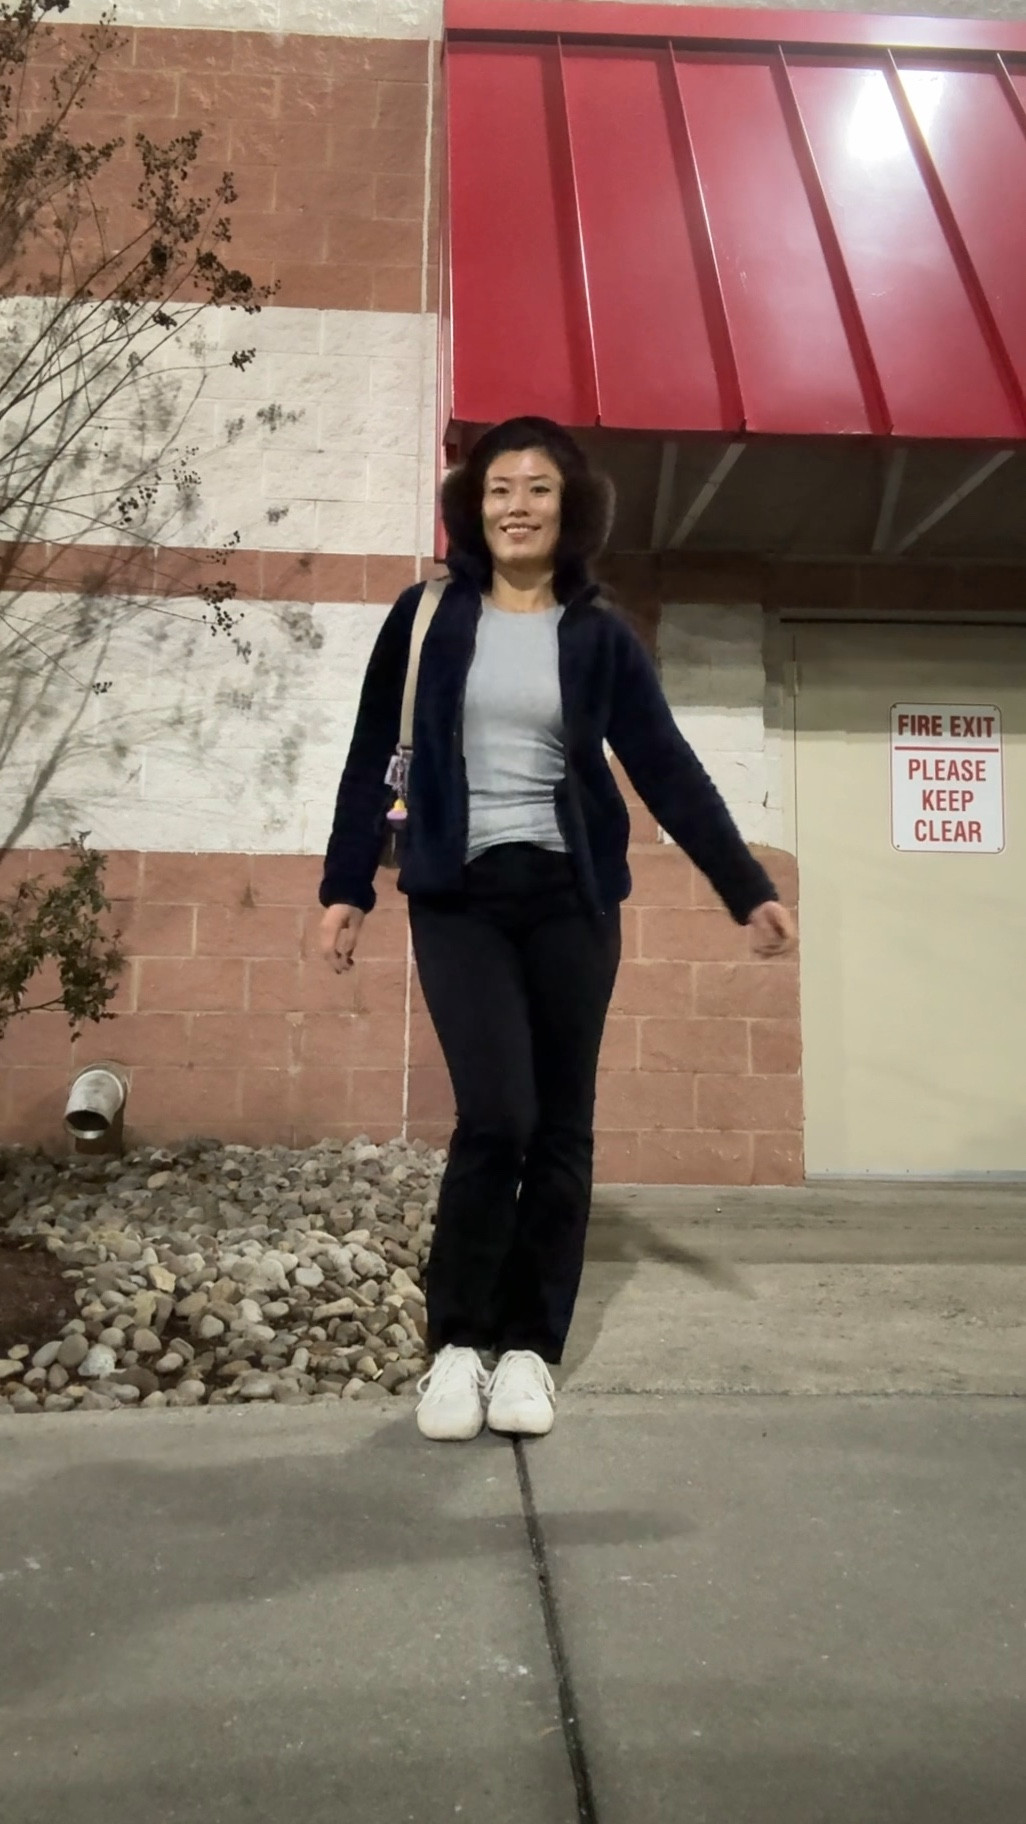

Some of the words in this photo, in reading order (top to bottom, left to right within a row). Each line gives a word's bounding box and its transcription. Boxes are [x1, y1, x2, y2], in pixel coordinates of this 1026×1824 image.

[897, 714, 943, 737] FIRE
[950, 715, 995, 738] EXIT
[908, 759, 987, 782] PLEASE
[922, 789, 974, 812] KEEP
[914, 819, 982, 843] CLEAR
